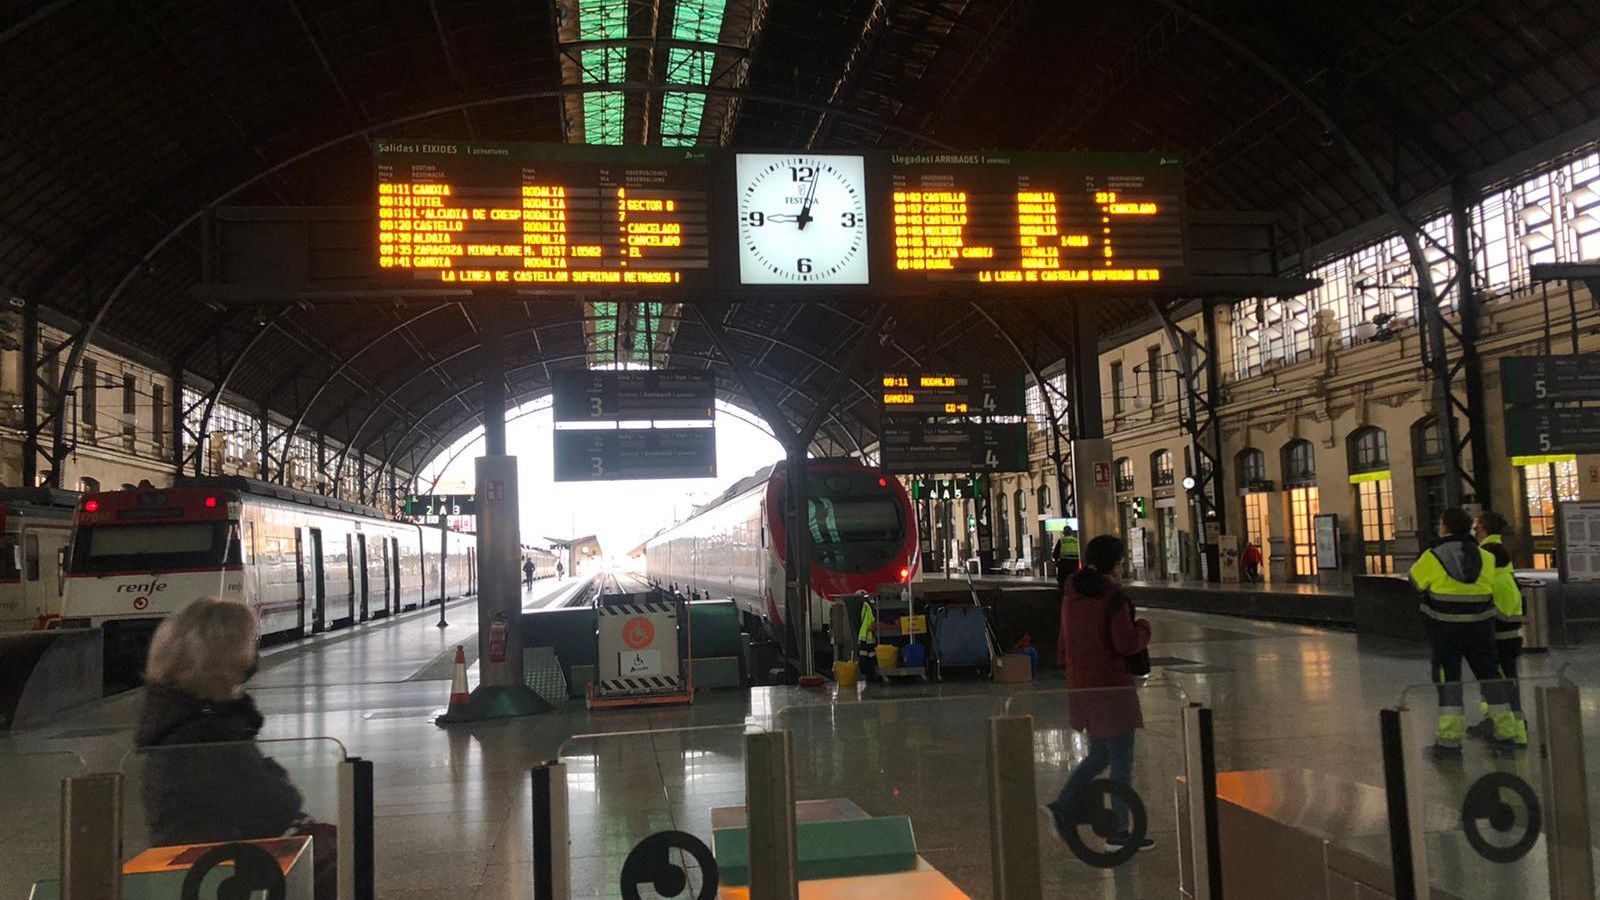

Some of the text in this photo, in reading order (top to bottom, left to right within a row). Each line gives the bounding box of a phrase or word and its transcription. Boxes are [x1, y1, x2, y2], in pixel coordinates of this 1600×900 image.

[378, 144, 413, 153] Salidas
[422, 145, 457, 154] EIXIDES
[892, 155, 931, 165] Llegadas
[934, 156, 979, 164] ARRIBADES
[789, 167, 813, 182] 12
[412, 185, 450, 195] GANDIA
[522, 187, 565, 197] RODALIA
[618, 188, 625, 198] 4
[413, 196, 444, 207] UTIEL
[523, 198, 565, 209] RODALIA
[619, 200, 627, 210] 2
[627, 200, 662, 210] SECTOR
[473, 209, 486, 220] DE
[490, 210, 523, 220] CRESP
[522, 210, 565, 220] RODALIA
[749, 212, 764, 227] 9
[841, 213, 855, 228] 3
[523, 222, 566, 232] RODALIA
[628, 223, 680, 234] CANCELADO
[412, 233, 451, 243] ALDAIA
[523, 234, 566, 244] RODALIA
[628, 235, 680, 246] CANCELADO
[412, 245, 463, 255] ZARAGOZA
[467, 245, 524, 256] MIRAFLORE
[413, 257, 451, 267] GANDIA
[524, 258, 567, 268] RODALIA
[797, 258, 812, 273] 6
[442, 271, 455, 281] LA
[496, 271, 509, 281] DE
[624, 272, 671, 282] RETRASOS
[979, 271, 992, 282] LA
[1025, 271, 1038, 281] DE
[884, 378, 954, 386] 09:11 RODALIA
[1535, 380, 1546, 398] 5
[591, 398, 602, 417] 3
[983, 393, 996, 411] 4
[1540, 433, 1551, 451] 5
[985, 450, 998, 468] 4
[592, 457, 603, 476] 3
[943, 489, 950, 499] A
[439, 505, 447, 515] A
[453, 505, 460, 515] 3
[117, 579, 168, 595] renfe
